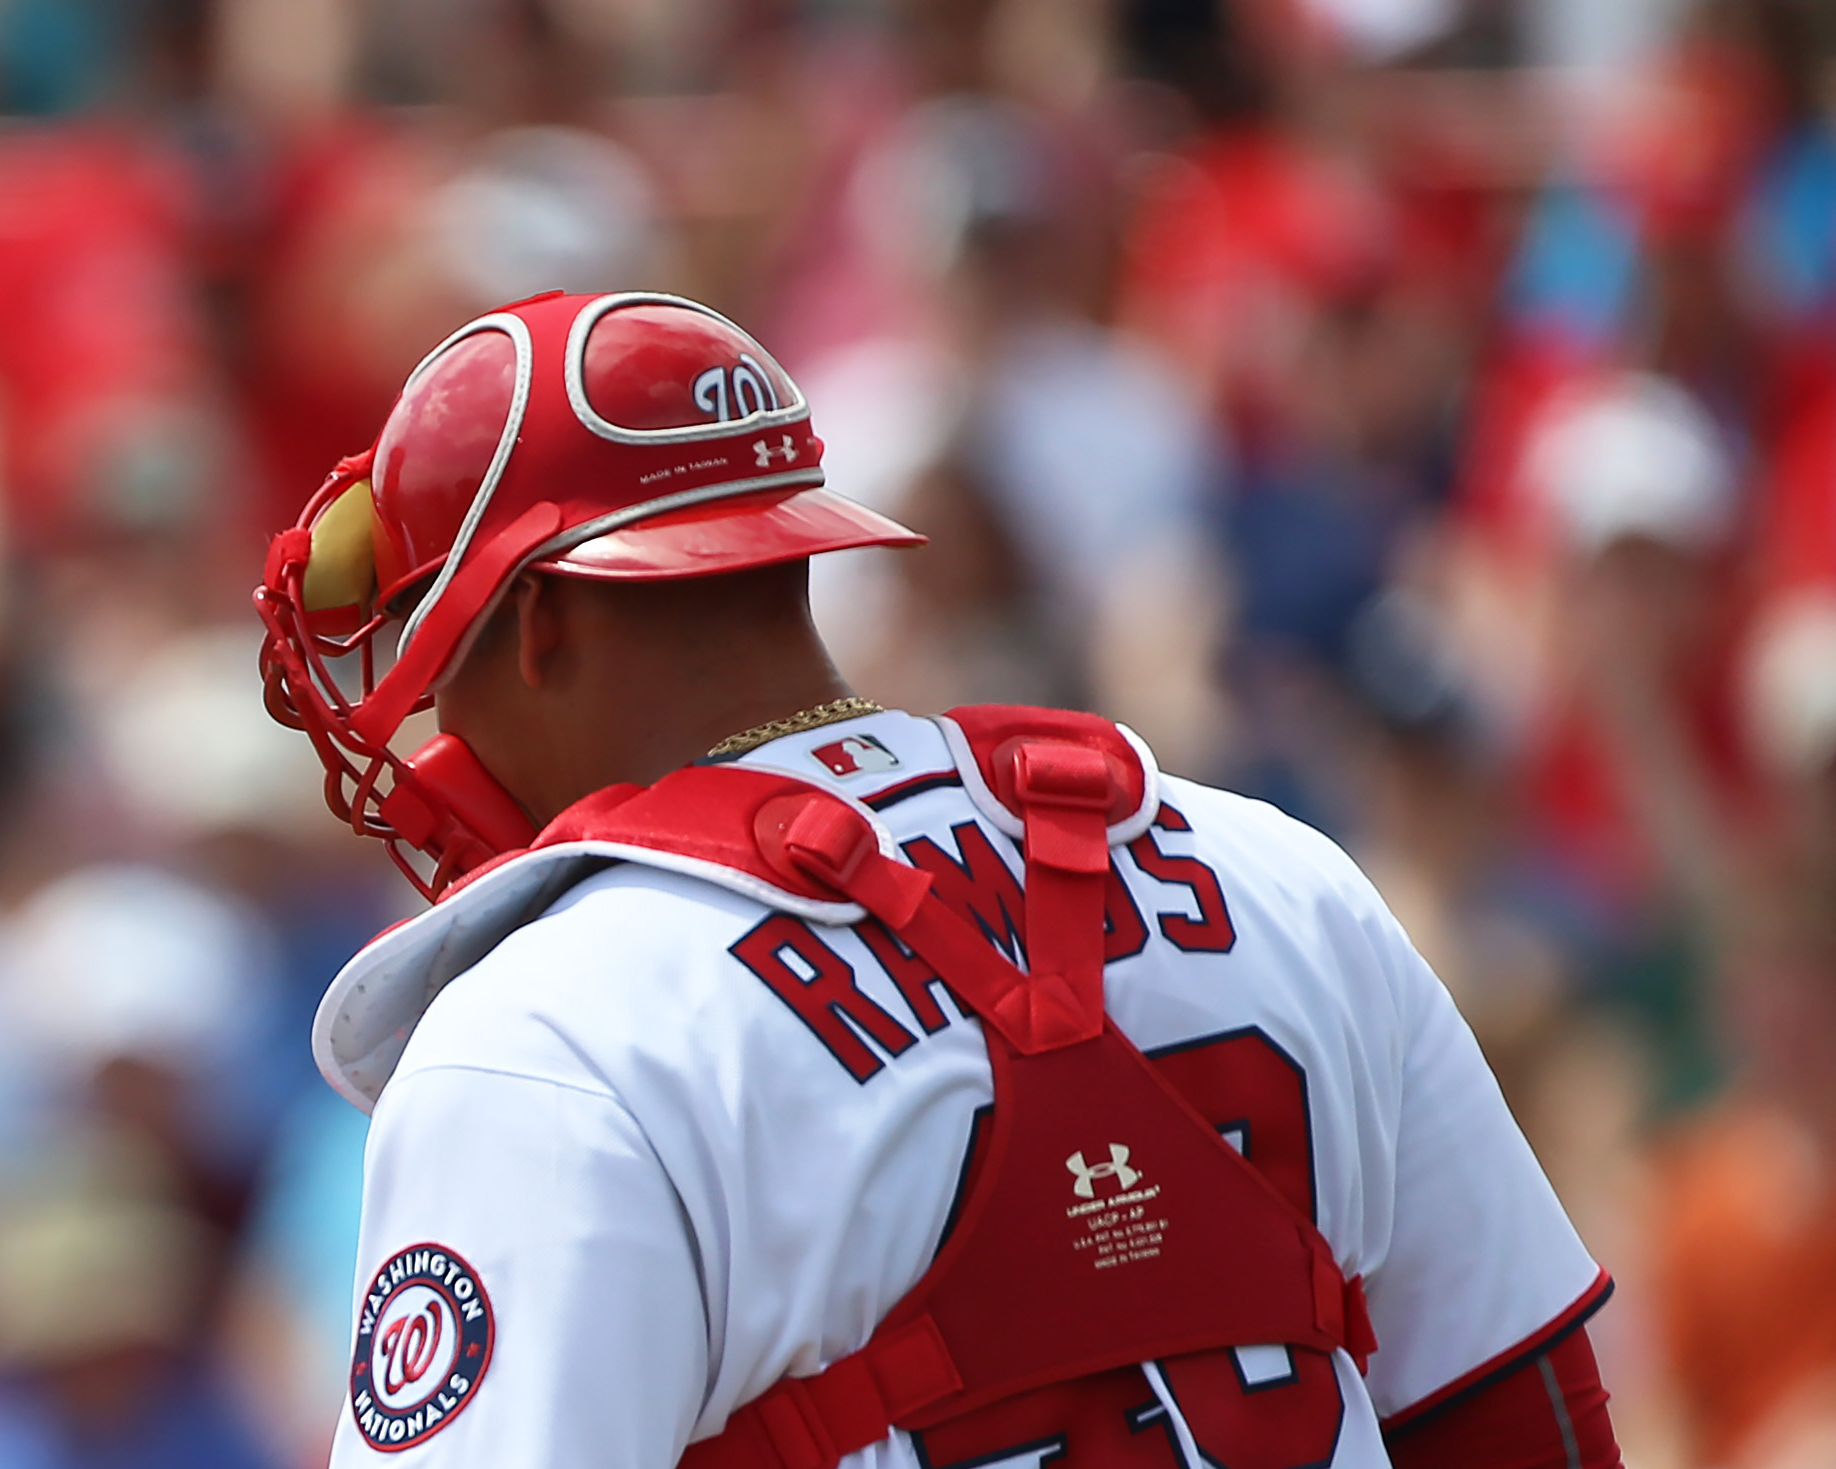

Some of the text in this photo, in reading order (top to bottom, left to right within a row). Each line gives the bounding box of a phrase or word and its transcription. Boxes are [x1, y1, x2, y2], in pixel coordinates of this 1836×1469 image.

[639, 457, 729, 485] MADE IN TAIWAN
[360, 1250, 484, 1336] WASHINGTON
[382, 1299, 442, 1396] W
[354, 1372, 470, 1442] NATIONALS
